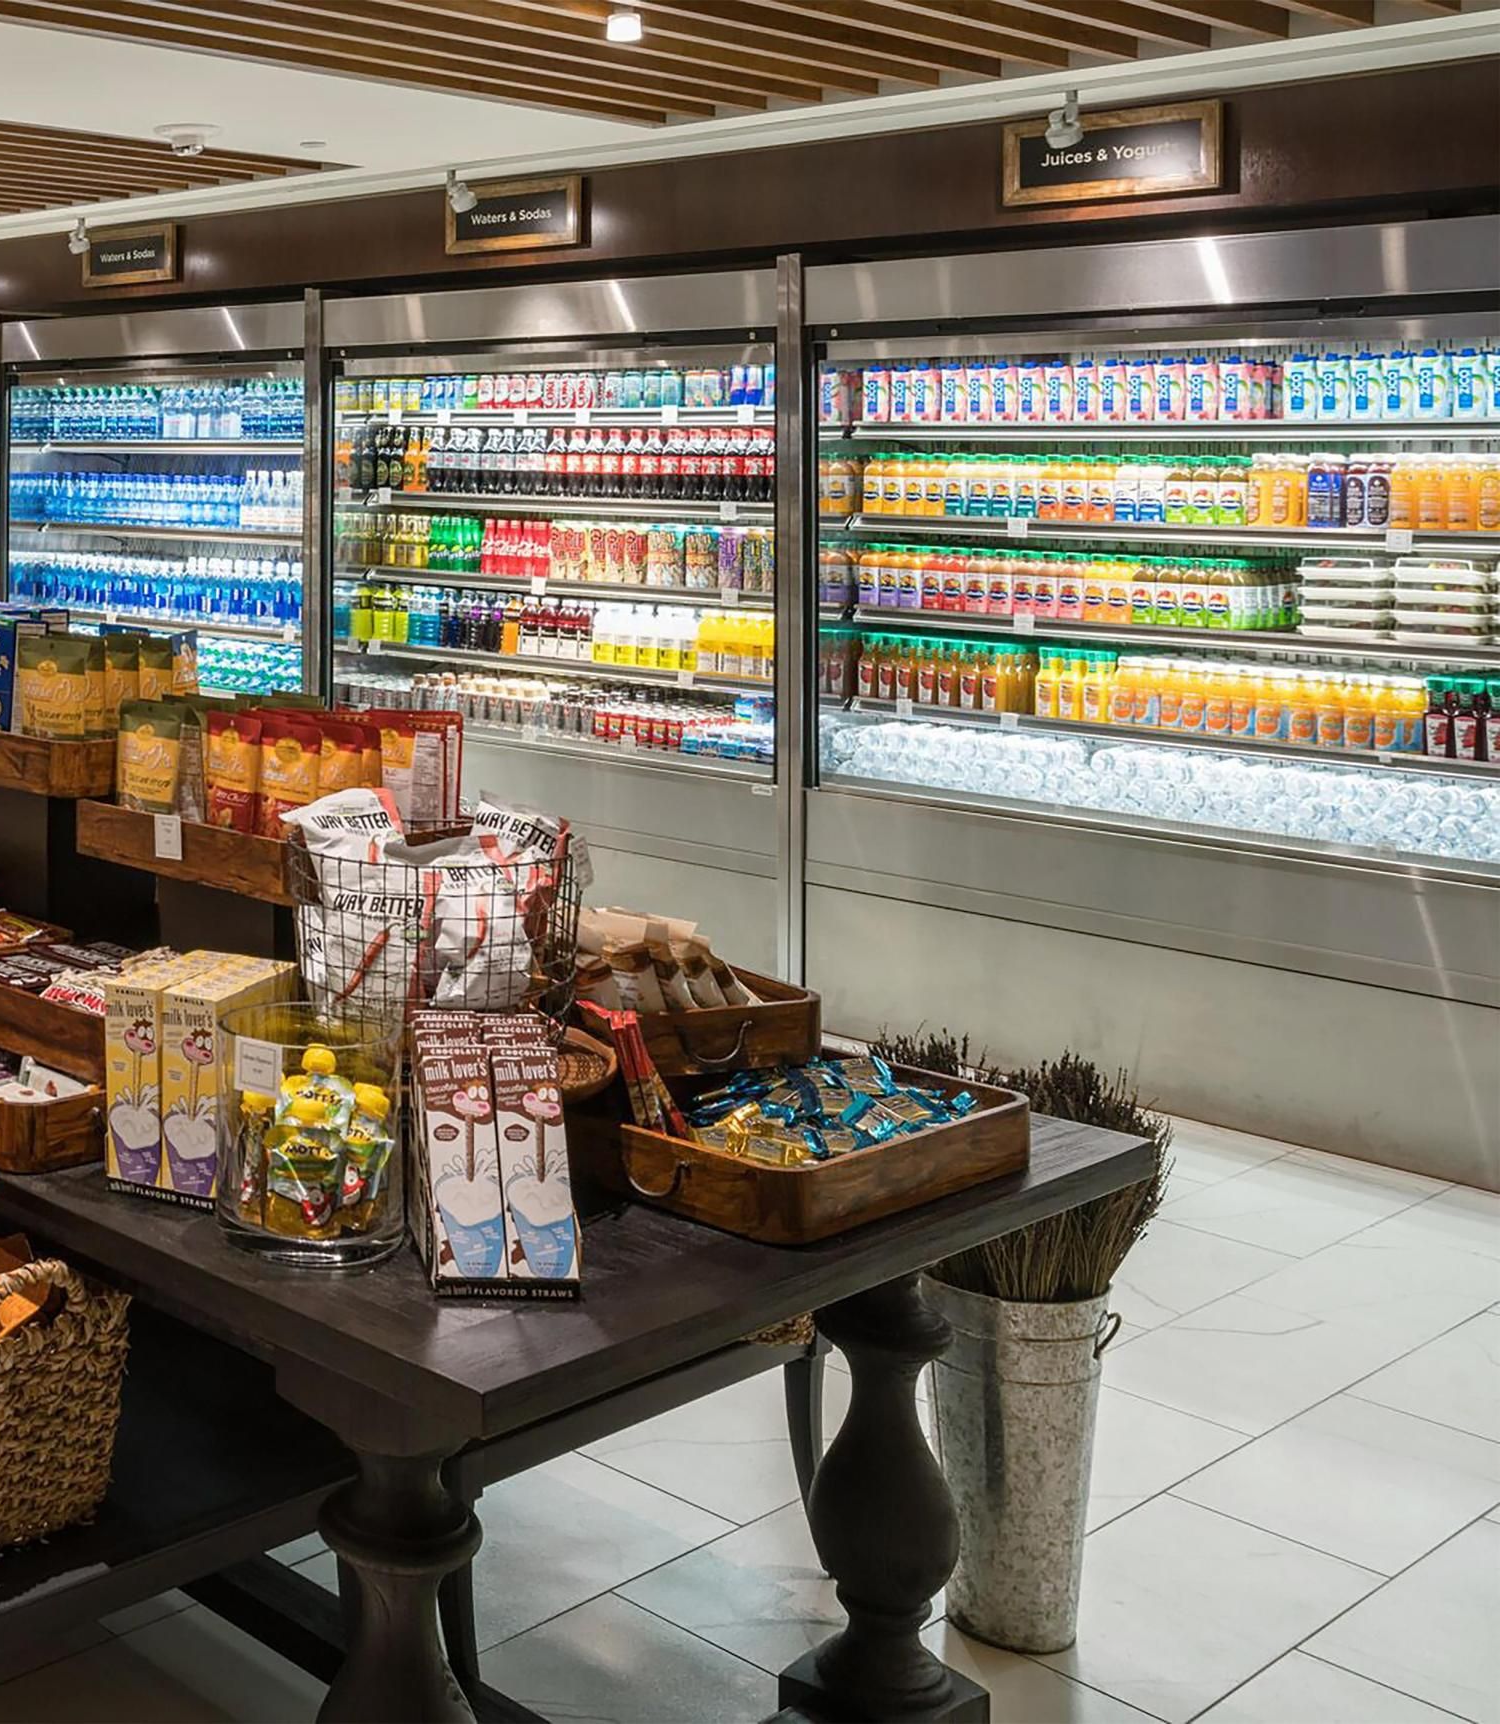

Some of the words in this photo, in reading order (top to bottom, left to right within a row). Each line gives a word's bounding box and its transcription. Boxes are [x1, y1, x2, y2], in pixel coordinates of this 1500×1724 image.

[1041, 151, 1092, 167] Juices
[1096, 149, 1108, 162] &
[471, 213, 507, 225] Waters
[509, 211, 516, 221] &
[519, 208, 552, 220] Sodas
[100, 252, 125, 263] Waters
[126, 251, 132, 260] &
[133, 248, 156, 260] Sodas
[311, 815, 344, 830] WAY
[344, 811, 392, 830] BETTER
[476, 811, 510, 832] WAY
[509, 818, 557, 857] BETTER
[334, 894, 368, 912] WAY
[369, 896, 424, 920] BETTER
[115, 988, 145, 997] VANILLA
[125, 999, 154, 1019] lover's
[174, 998, 205, 1007] VANILLA
[161, 1007, 183, 1025] milk
[183, 1009, 213, 1029] lover's
[492, 1026, 543, 1034] CHOCOLATE
[429, 1048, 482, 1056] CHOCOLATE
[500, 1050, 552, 1058] CHOCOLATE
[424, 1061, 450, 1081] milk
[451, 1058, 488, 1079] lover's
[493, 1062, 520, 1081] milk
[520, 1059, 557, 1079] lover's
[136, 1187, 178, 1203] FLAVORED
[180, 1196, 214, 1210] STRAWS
[474, 1286, 528, 1297] FLAVORED
[531, 1289, 574, 1298] STRAWS
